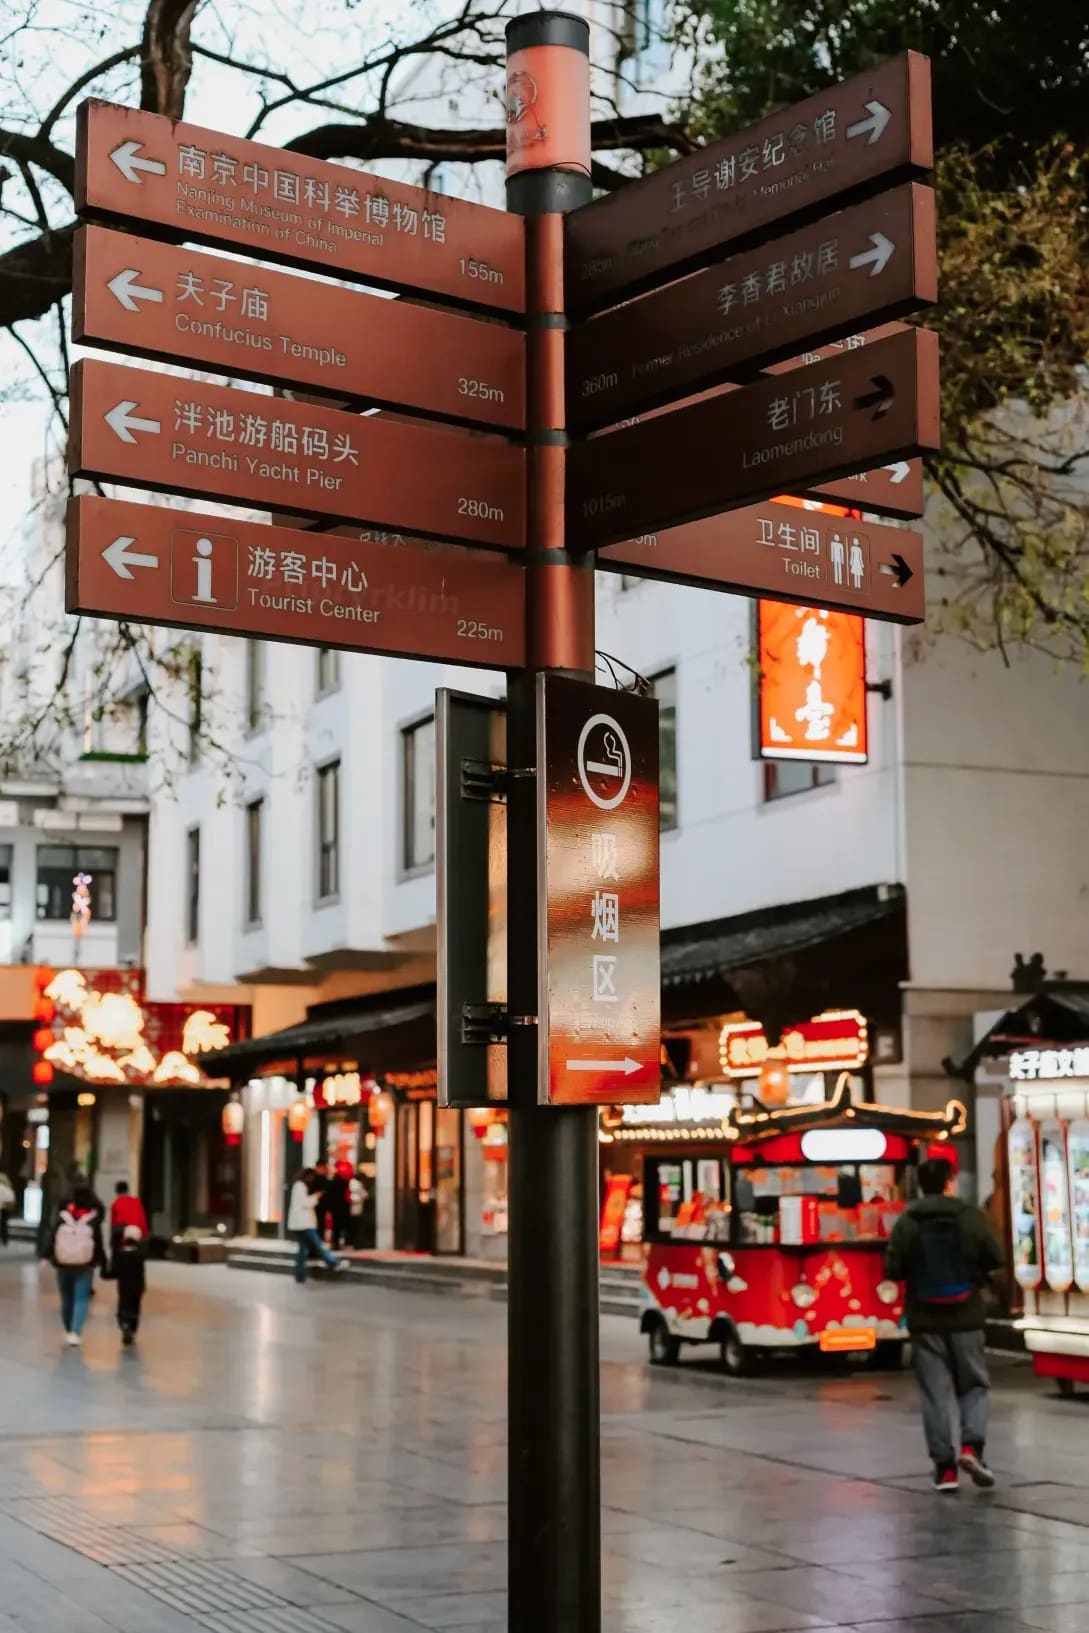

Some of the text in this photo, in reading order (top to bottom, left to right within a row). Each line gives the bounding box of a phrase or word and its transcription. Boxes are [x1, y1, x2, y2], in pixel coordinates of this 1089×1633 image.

[670, 109, 837, 213] 王导谢安纪念馆
[176, 182, 385, 246] Nanjing Museum of Imperial
[177, 144, 448, 243] 南京中国科举博物馆
[176, 200, 338, 253] Examination of China
[176, 270, 270, 321] 夫子庙
[458, 257, 504, 286] 155m
[716, 239, 839, 317] 李香君故居
[175, 313, 347, 369] Confucius Temple
[457, 377, 504, 403] 325m
[581, 373, 618, 398] 360m
[767, 379, 843, 432] 老门东
[172, 399, 359, 467] 泮池游船码头
[741, 424, 844, 469] Laomendong
[172, 443, 343, 492] Panchi Yacht Pier
[457, 497, 504, 522] 280m
[755, 518, 821, 556] 卫生间
[247, 545, 369, 594] 游客中心
[782, 557, 821, 580] Toilet
[247, 588, 313, 615] Tourist
[319, 599, 381, 624] Center
[457, 619, 503, 643] 225m
[591, 832, 620, 1003] 吸烟区
